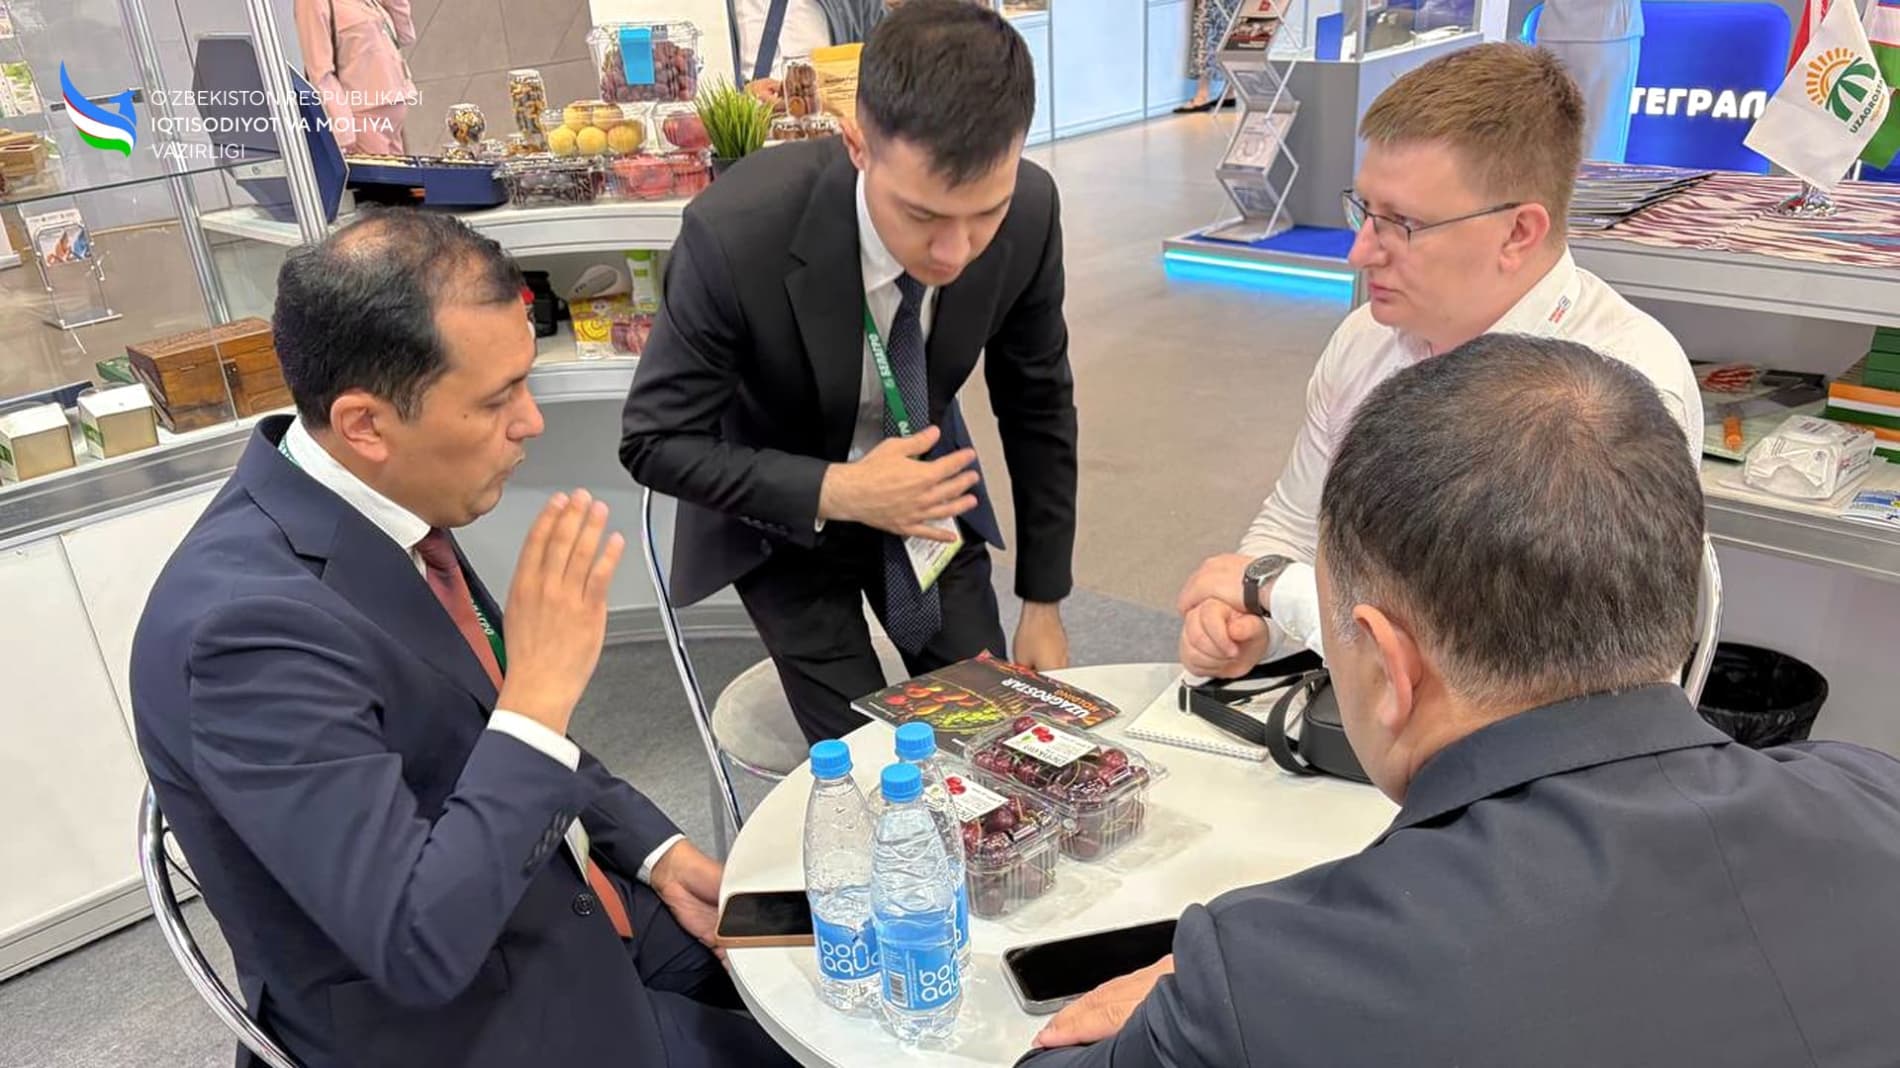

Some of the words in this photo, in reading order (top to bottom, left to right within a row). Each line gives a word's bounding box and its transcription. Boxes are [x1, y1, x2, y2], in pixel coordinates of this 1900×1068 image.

[1629, 87, 1767, 119] ТЕГРАЛ
[1849, 79, 1883, 133] UZAGROSTA
[1001, 678, 1090, 719] UZAGROSTAR
[921, 972, 957, 1002] aqu
